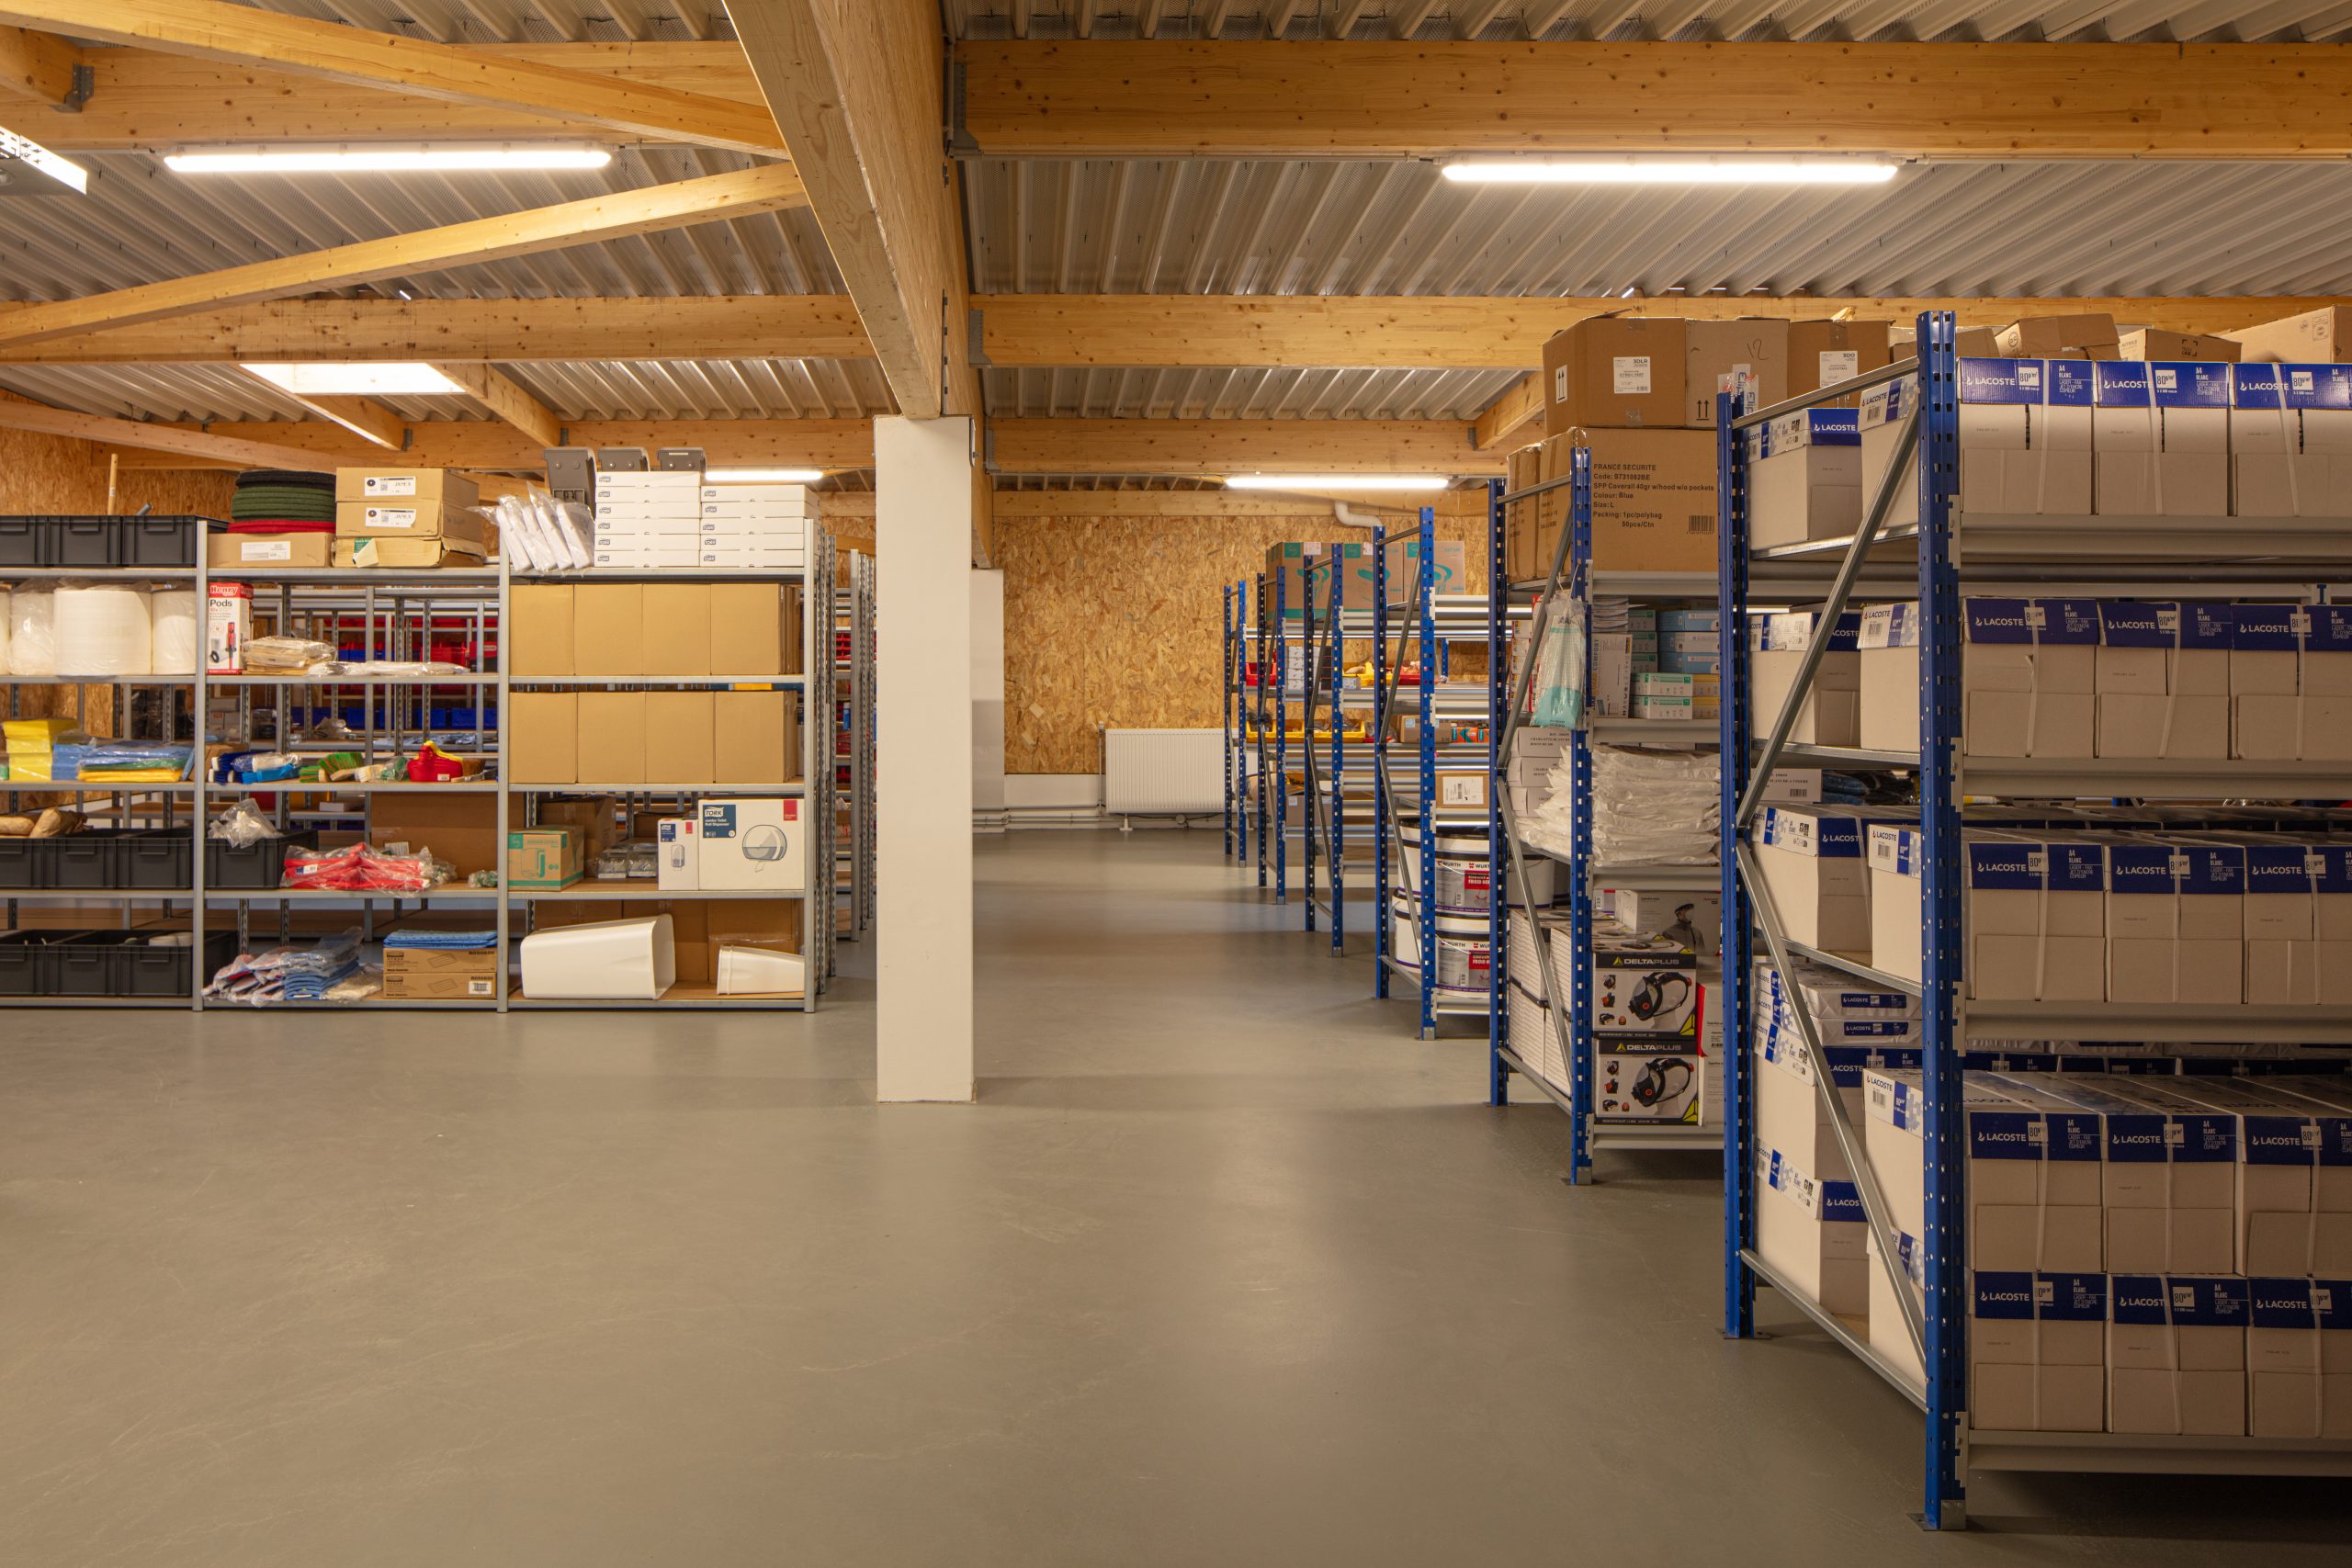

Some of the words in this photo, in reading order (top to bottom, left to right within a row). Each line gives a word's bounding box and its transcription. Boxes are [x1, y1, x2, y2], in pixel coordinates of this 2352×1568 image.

[1974, 378, 2015, 386] LACOSTE
[2112, 380, 2148, 389] LACOST
[1866, 392, 1887, 404] LACOSTE
[1592, 511, 1621, 519] Packing:
[210, 585, 238, 595] Henry
[210, 599, 232, 607] Pods
[1869, 610, 1891, 618] LACOSTE
[2026, 611, 2043, 621] 8g/m²
[1984, 618, 2024, 626] LACOSTE
[2117, 621, 2155, 629] LACOSTE
[2249, 625, 2290, 633] LACOSTE
[1876, 832, 1896, 841] LACOSTE
[1985, 863, 2027, 872] LACOSTE
[2125, 866, 2166, 874] LACOSTE
[2170, 861, 2188, 871] 8g/m²
[2261, 866, 2302, 874] LACOSTE
[1871, 1077, 1893, 1091] LACOSTE
[1986, 1134, 2027, 1142] LACOSTE
[2121, 1135, 2161, 1144] LACOSTE
[2260, 1137, 2301, 1145] LACOSTE
[1989, 1292, 2029, 1301] LACOSTE
[2128, 1298, 2165, 1307] LACOST
[2265, 1300, 2307, 1309] LACOSTE
